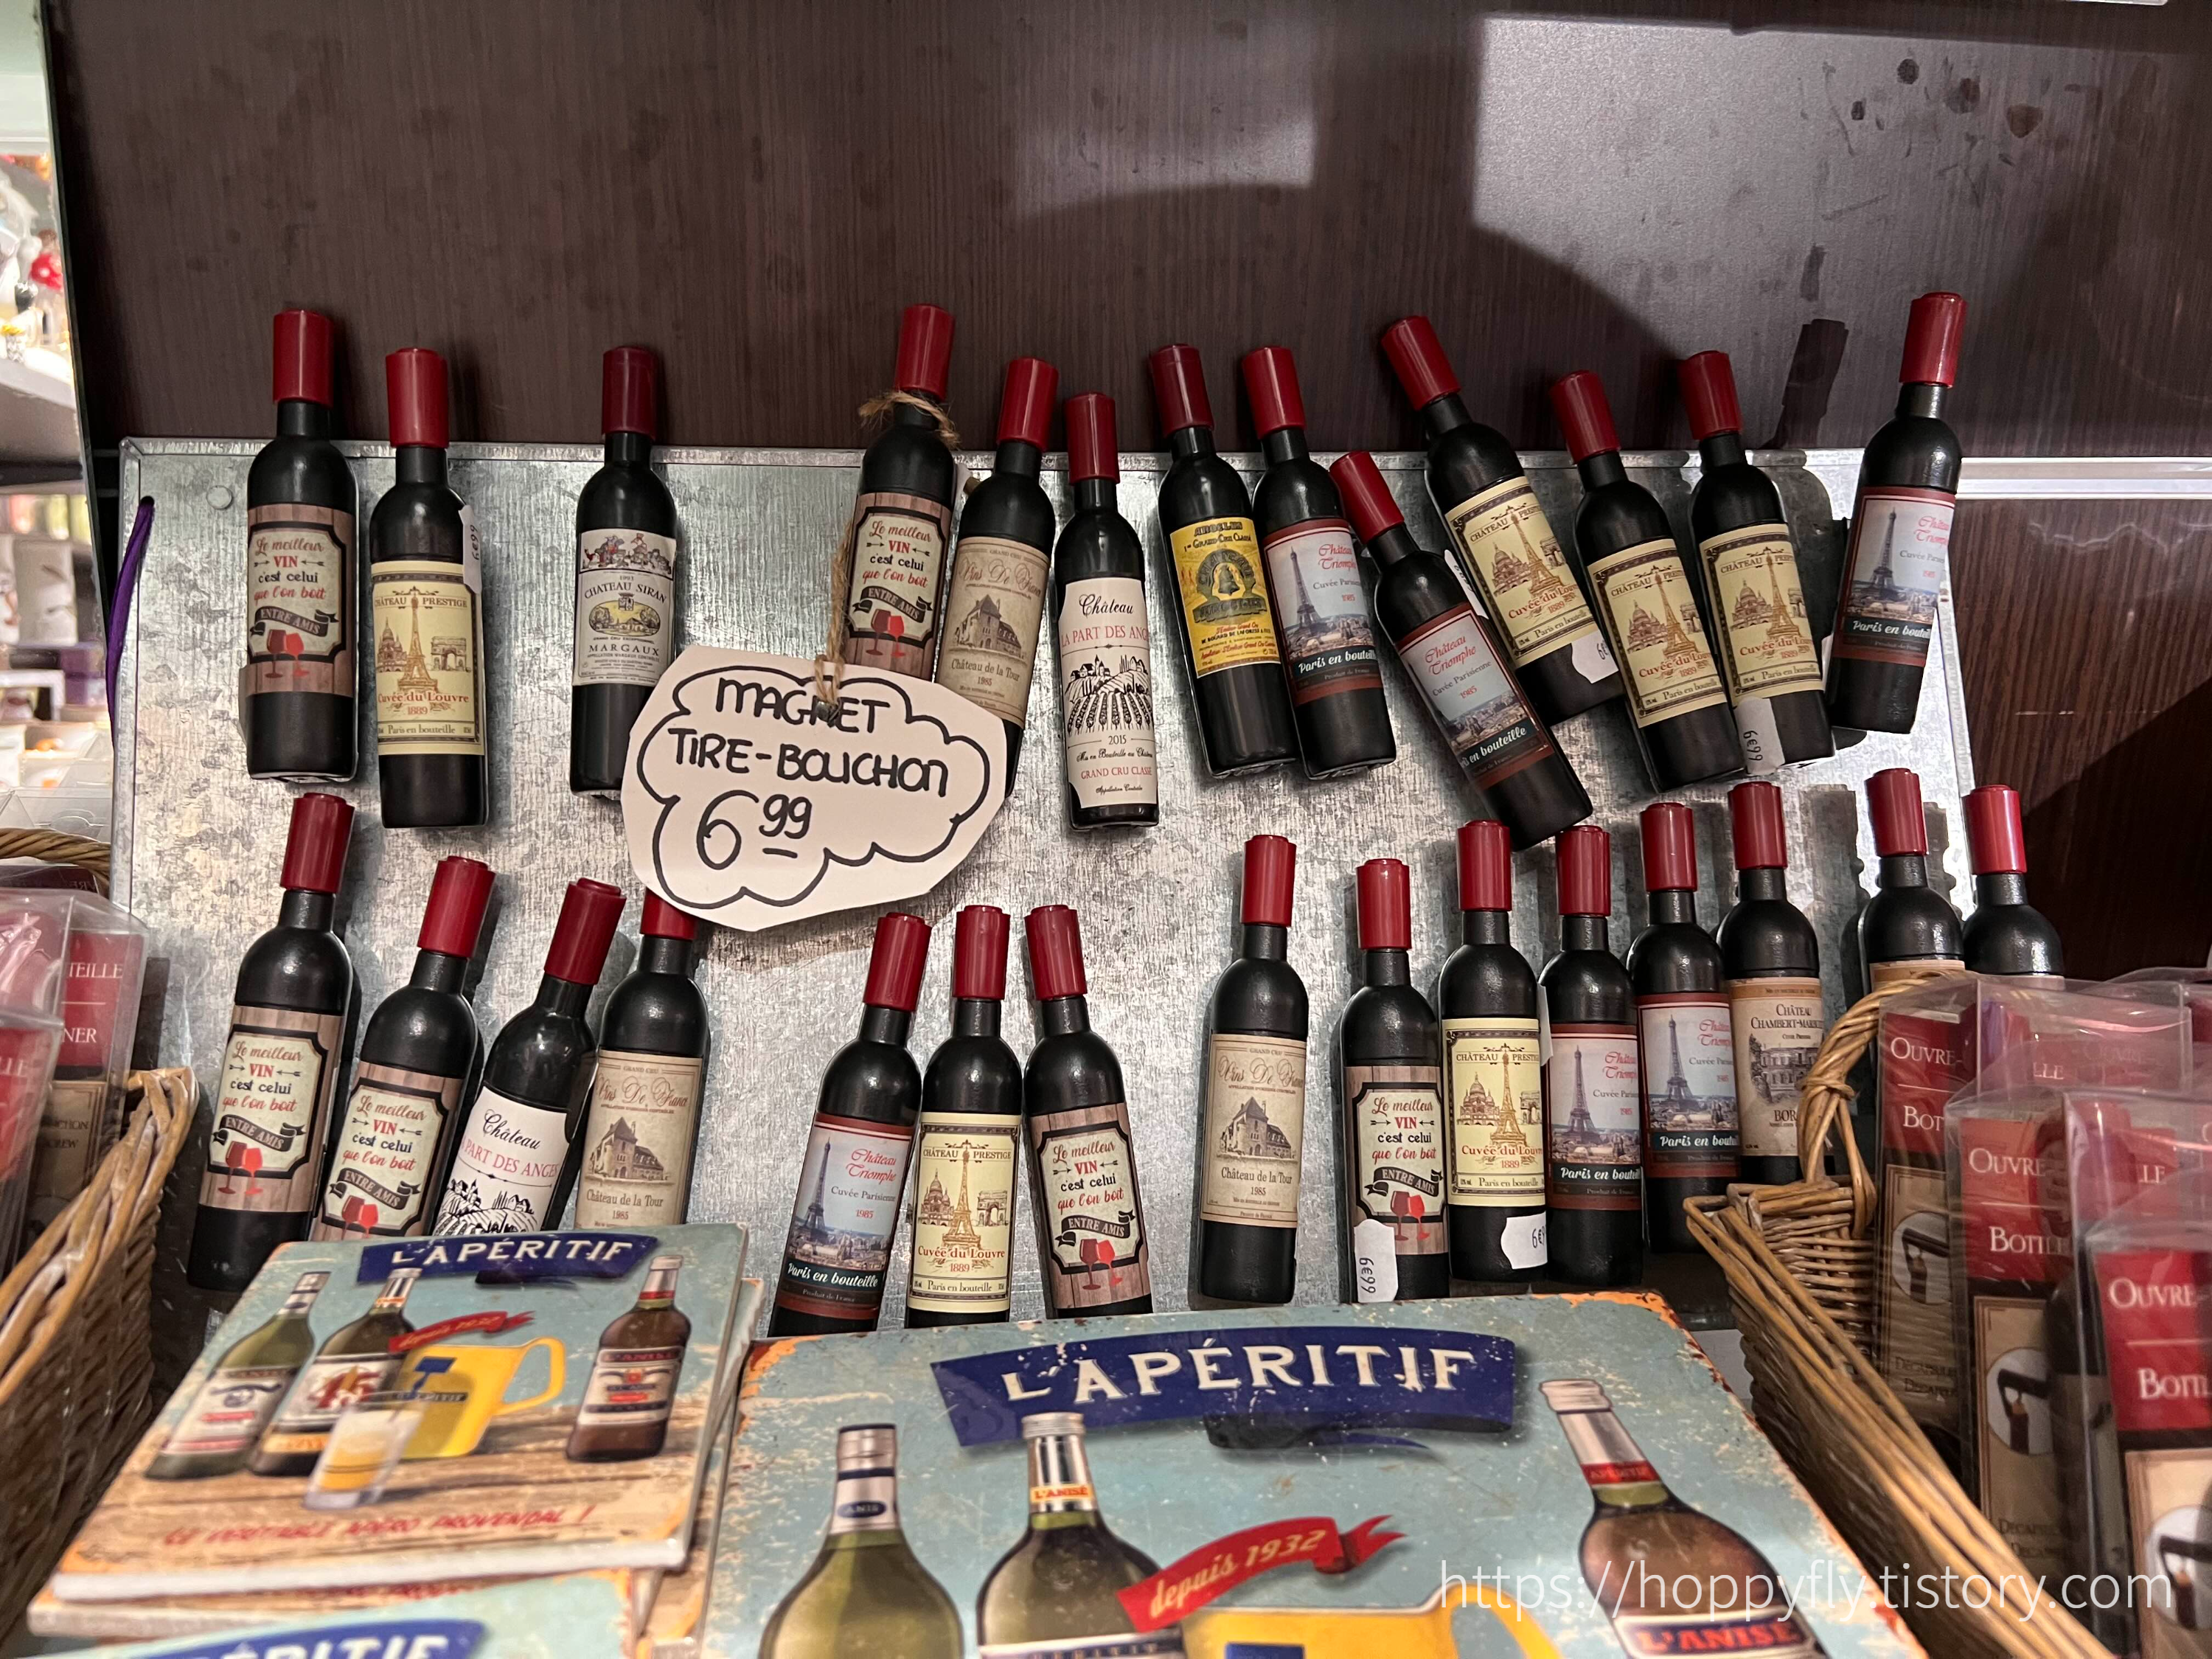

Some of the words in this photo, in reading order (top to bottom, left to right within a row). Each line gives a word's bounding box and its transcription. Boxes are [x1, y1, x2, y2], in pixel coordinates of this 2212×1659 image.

[869, 521, 885, 540] Le
[888, 525, 932, 542] meilleur
[1470, 519, 1508, 542] CHÂTEAU
[888, 540, 911, 553] VIN
[274, 556, 298, 568] VIN
[870, 553, 893, 565] c'est
[898, 558, 924, 571] celui
[1720, 557, 1762, 574] CHÂTEAU
[863, 570, 880, 584] que
[883, 568, 904, 582] l'on
[908, 573, 928, 588] boit
[585, 582, 631, 599] CHATEAU
[636, 584, 667, 603] SIRAN
[1611, 577, 1652, 597] CHÂTEAU
[375, 595, 406, 607] CHÂTEAU
[422, 598, 467, 608] PRESTIGE
[869, 588, 897, 605] ENTRE
[899, 602, 920, 620] AMIS
[1079, 594, 1134, 616] Château
[1509, 599, 1540, 619] Cuvée
[1543, 592, 1557, 602] du
[260, 608, 292, 622] ENTRE
[293, 618, 321, 634] AMIS
[1073, 627, 1099, 641] PART
[1105, 625, 1126, 638] DES
[1130, 626, 1149, 641] ANG
[589, 644, 659, 655] MARGAUX
[1425, 636, 1466, 663] Château
[1739, 643, 1775, 655] Cuvée
[1298, 656, 1326, 674] Paris
[1329, 654, 1343, 665] en
[1429, 646, 1475, 675] Triomphe
[1639, 661, 1672, 678] Cuvée
[1676, 658, 1690, 666] du
[951, 658, 983, 671] Château
[984, 663, 995, 674] de
[997, 664, 1004, 675] la
[1006, 667, 1020, 681] Tour
[978, 677, 992, 686] 1985
[1433, 681, 1453, 696] Cuvée
[1453, 661, 1492, 684] Parisienne
[378, 692, 403, 703] Cuvée
[406, 692, 422, 701] du
[428, 692, 469, 703] Louvre
[1460, 686, 1477, 699] 1985
[388, 725, 405, 734] Paris
[419, 725, 455, 734] bouteille
[1108, 736, 1127, 745] 2015
[1470, 752, 1481, 763] en
[1481, 726, 1526, 757] bouteille
[669, 728, 947, 797] TIRE-BOUCHON
[1081, 768, 1108, 779] GRAND
[1111, 768, 1129, 776] CRU
[69, 962, 123, 978] TEILLE
[1776, 1004, 1811, 1017] CHÂTEAU
[62, 1028, 97, 1043] NER
[232, 1041, 246, 1062] Le
[250, 1046, 303, 1062] meilleur
[1457, 1052, 1498, 1061] CHÂTEAU
[249, 1063, 274, 1077] VIN
[231, 1078, 254, 1091] c'est
[258, 1083, 291, 1094] celui
[1371, 1097, 1388, 1116] Le
[1393, 1100, 1433, 1111] meilleur
[1395, 1117, 1416, 1129] VIN
[1775, 1110, 1797, 1121] BOR
[1903, 1105, 1945, 1131] BOT
[226, 1116, 255, 1136] ENTRE
[256, 1133, 285, 1149] AMIS
[373, 1119, 398, 1135] VIN
[483, 1109, 541, 1150] Château
[1378, 1132, 1402, 1143] c'est
[1408, 1132, 1431, 1143] celui
[465, 1139, 492, 1164] PART
[493, 1154, 519, 1173] DES
[522, 1162, 558, 1178] ANGES
[851, 1149, 896, 1166] Château
[923, 1147, 959, 1158] CHÂTEAU
[973, 1151, 1011, 1159] PRESTIGE
[1053, 1145, 1067, 1165] Le
[1071, 1141, 1116, 1158] meilleur
[1372, 1150, 1391, 1165] que
[1395, 1147, 1416, 1159] l'on
[1420, 1148, 1436, 1159] boit
[1462, 1146, 1497, 1155] Cuvée
[1500, 1146, 1515, 1155] du
[846, 1163, 896, 1185] Triomphe
[1074, 1161, 1097, 1175] VIN
[1222, 1167, 1254, 1180] Château
[1256, 1170, 1267, 1182] de
[1269, 1172, 1276, 1182] la
[1279, 1172, 1292, 1184] Tour
[1560, 1166, 1590, 1179] Paris
[1594, 1170, 1609, 1180] en
[344, 1170, 375, 1191] ENTRE
[375, 1189, 400, 1208] AMIS
[1061, 1179, 1084, 1192] c'est
[1090, 1173, 1116, 1186] celui
[1382, 1169, 1413, 1186] ENTRE
[1415, 1180, 1435, 1194] AMIS
[587, 1189, 616, 1204] Château
[620, 1193, 630, 1205] de
[633, 1194, 641, 1206] la
[645, 1197, 663, 1206] Tour
[831, 1186, 859, 1198] Cuvée
[1251, 1187, 1266, 1195] 1985
[1057, 1200, 1075, 1215] que
[1079, 1194, 1101, 1206] l'on
[1105, 1187, 1124, 1203] boit
[856, 1209, 874, 1219] 1985
[1069, 1217, 1099, 1231] ENTRE
[1102, 1224, 1124, 1237] AMIS
[392, 1239, 633, 1265] L'APÉRITIF
[918, 1245, 947, 1258] Cuvée
[950, 1249, 966, 1258] du
[971, 1248, 1004, 1258] Louvre
[788, 1263, 810, 1279] Paris
[813, 1271, 828, 1283] en
[831, 1273, 878, 1287] bouteille
[950, 1263, 970, 1273] 1889
[928, 1281, 945, 1291] Paris
[959, 1281, 992, 1291] bouteille
[1001, 1336, 1476, 1405] L'APÉRITIF
[1034, 1486, 1088, 1499] L'ANISÉ
[1150, 1554, 1239, 1618] depuis
[1245, 1529, 1326, 1568] 1932
